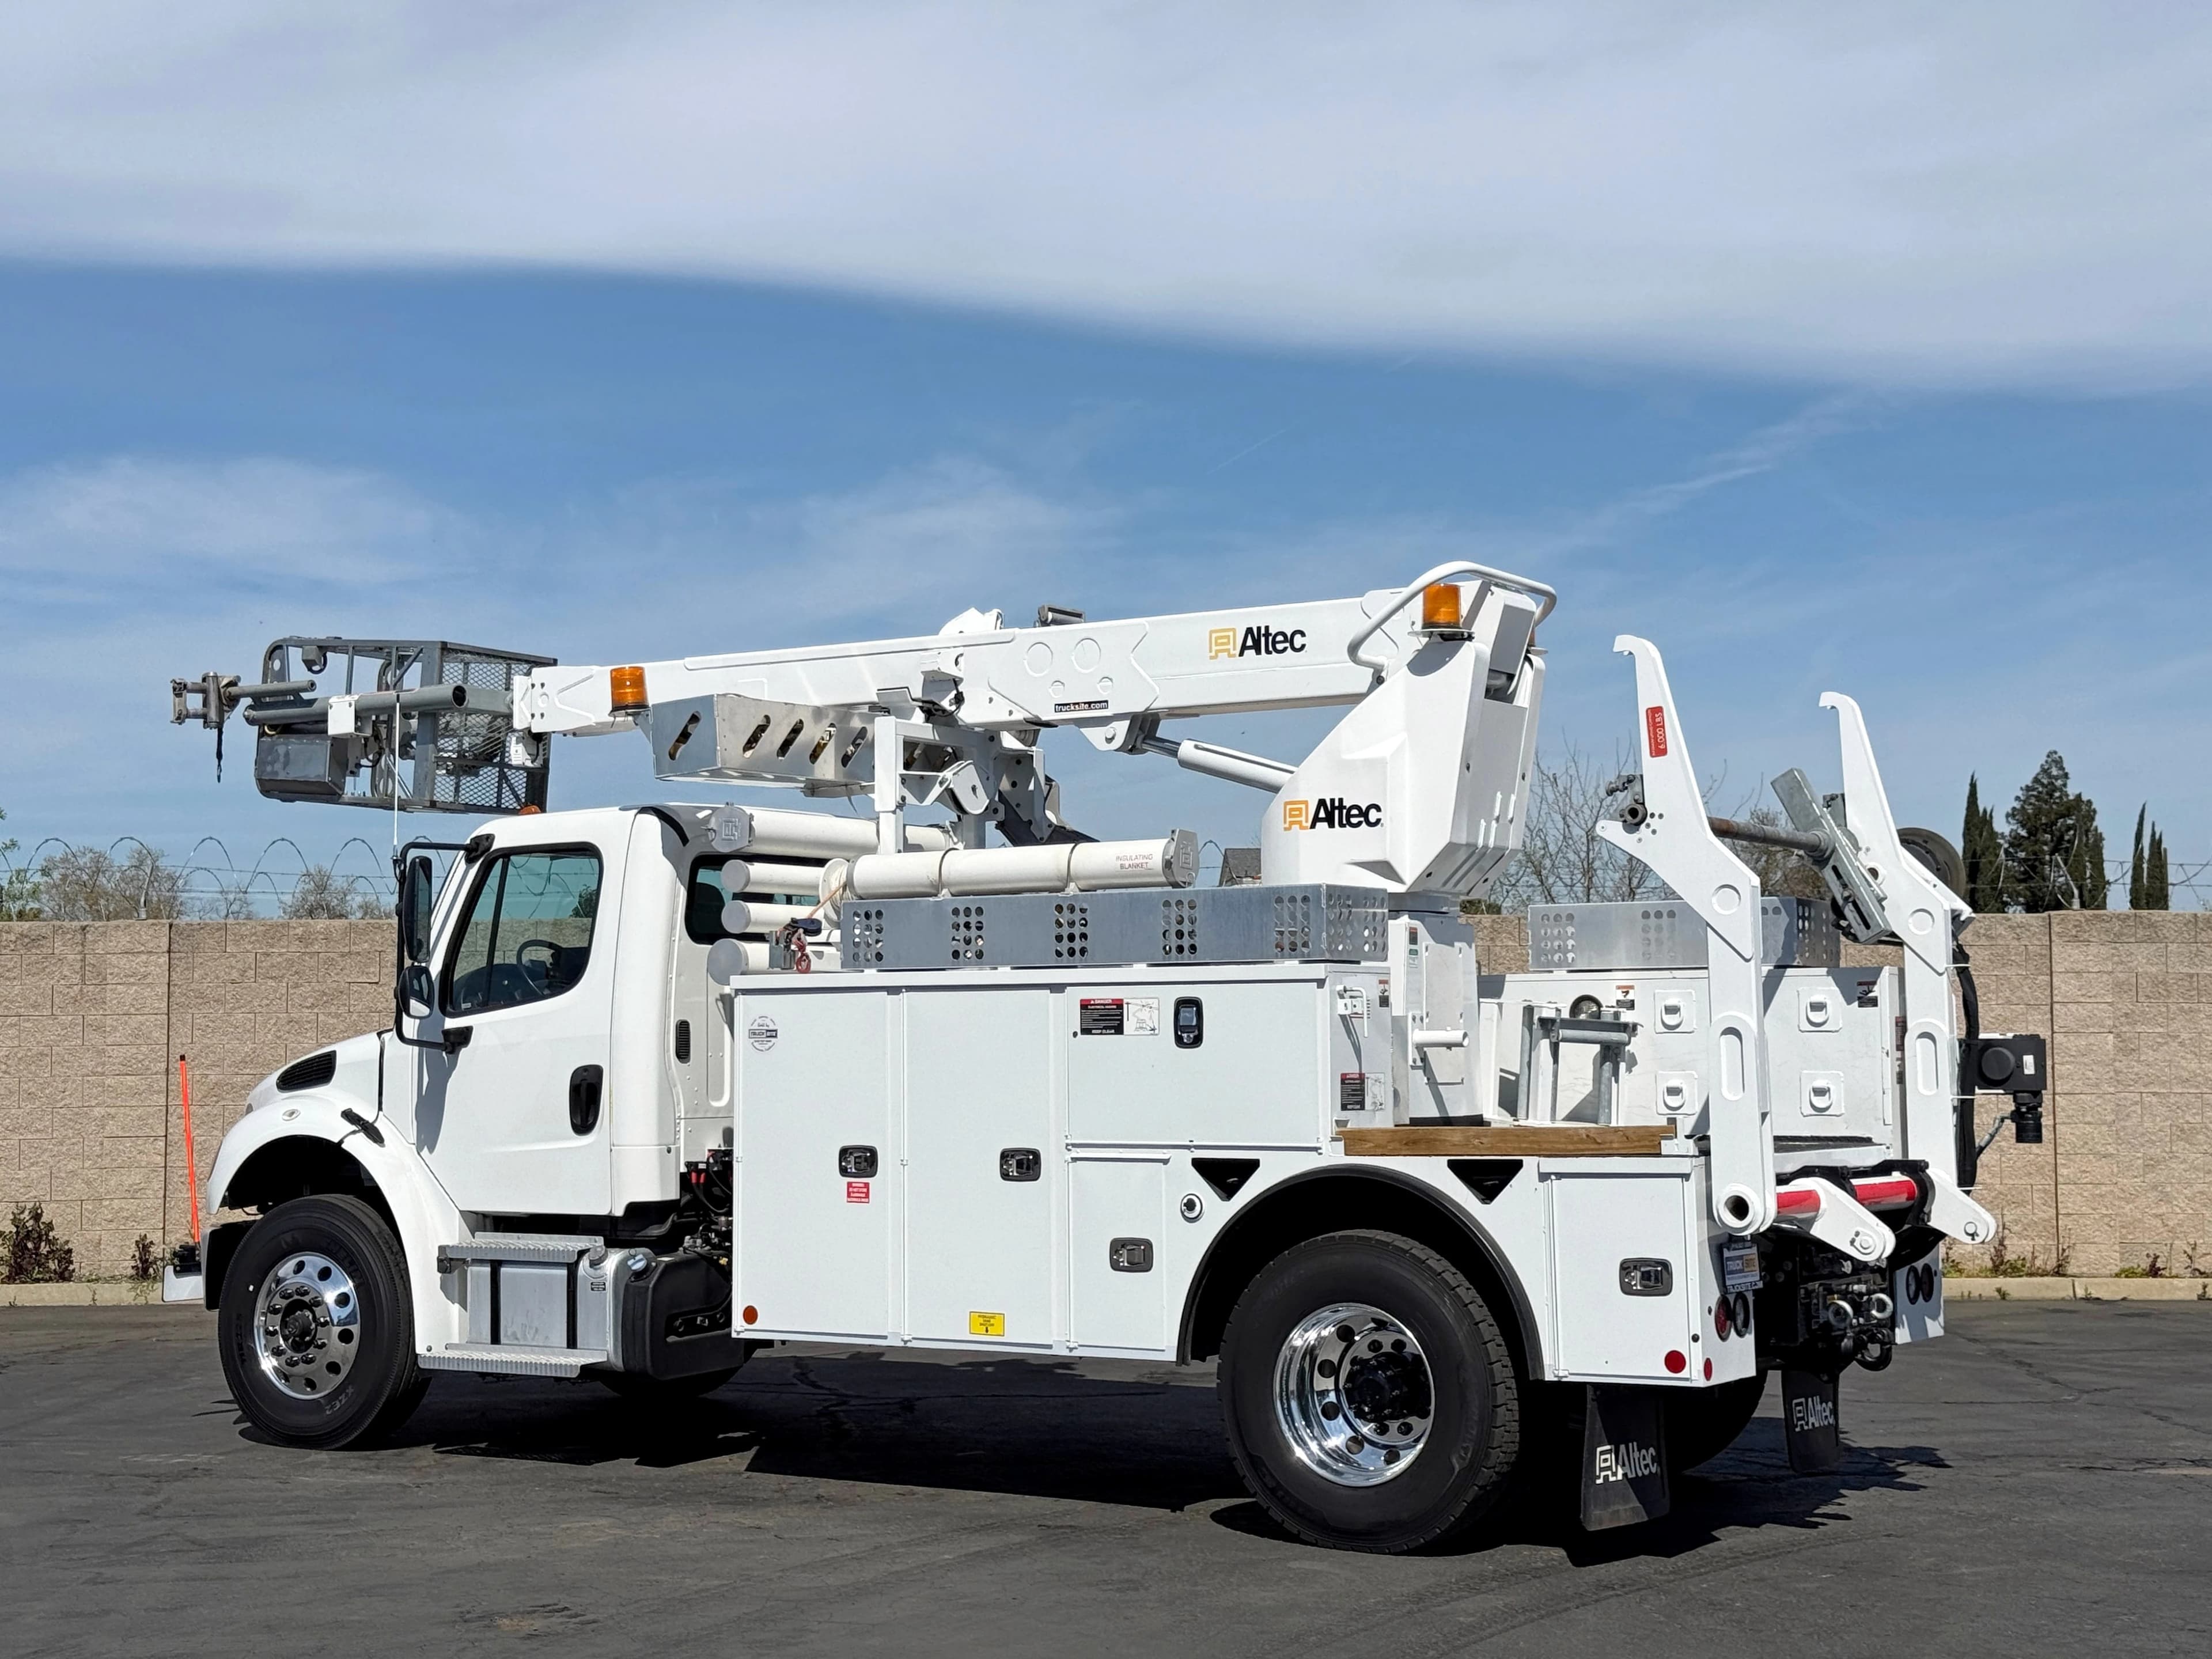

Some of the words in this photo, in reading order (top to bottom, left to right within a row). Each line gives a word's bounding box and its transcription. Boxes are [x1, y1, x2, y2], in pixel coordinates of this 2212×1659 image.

[1238, 625, 1306, 657] Altec
[1055, 702, 1107, 712] trucksite.com
[1655, 712, 1663, 726] LBS
[1309, 798, 1382, 830] Altec
[1116, 854, 1153, 862] INSULATING
[1120, 862, 1148, 870] BLANKET
[324, 1385, 354, 1414] XZE2
[1808, 1395, 1834, 1429] Altec
[1617, 1441, 1657, 1480] Altec
